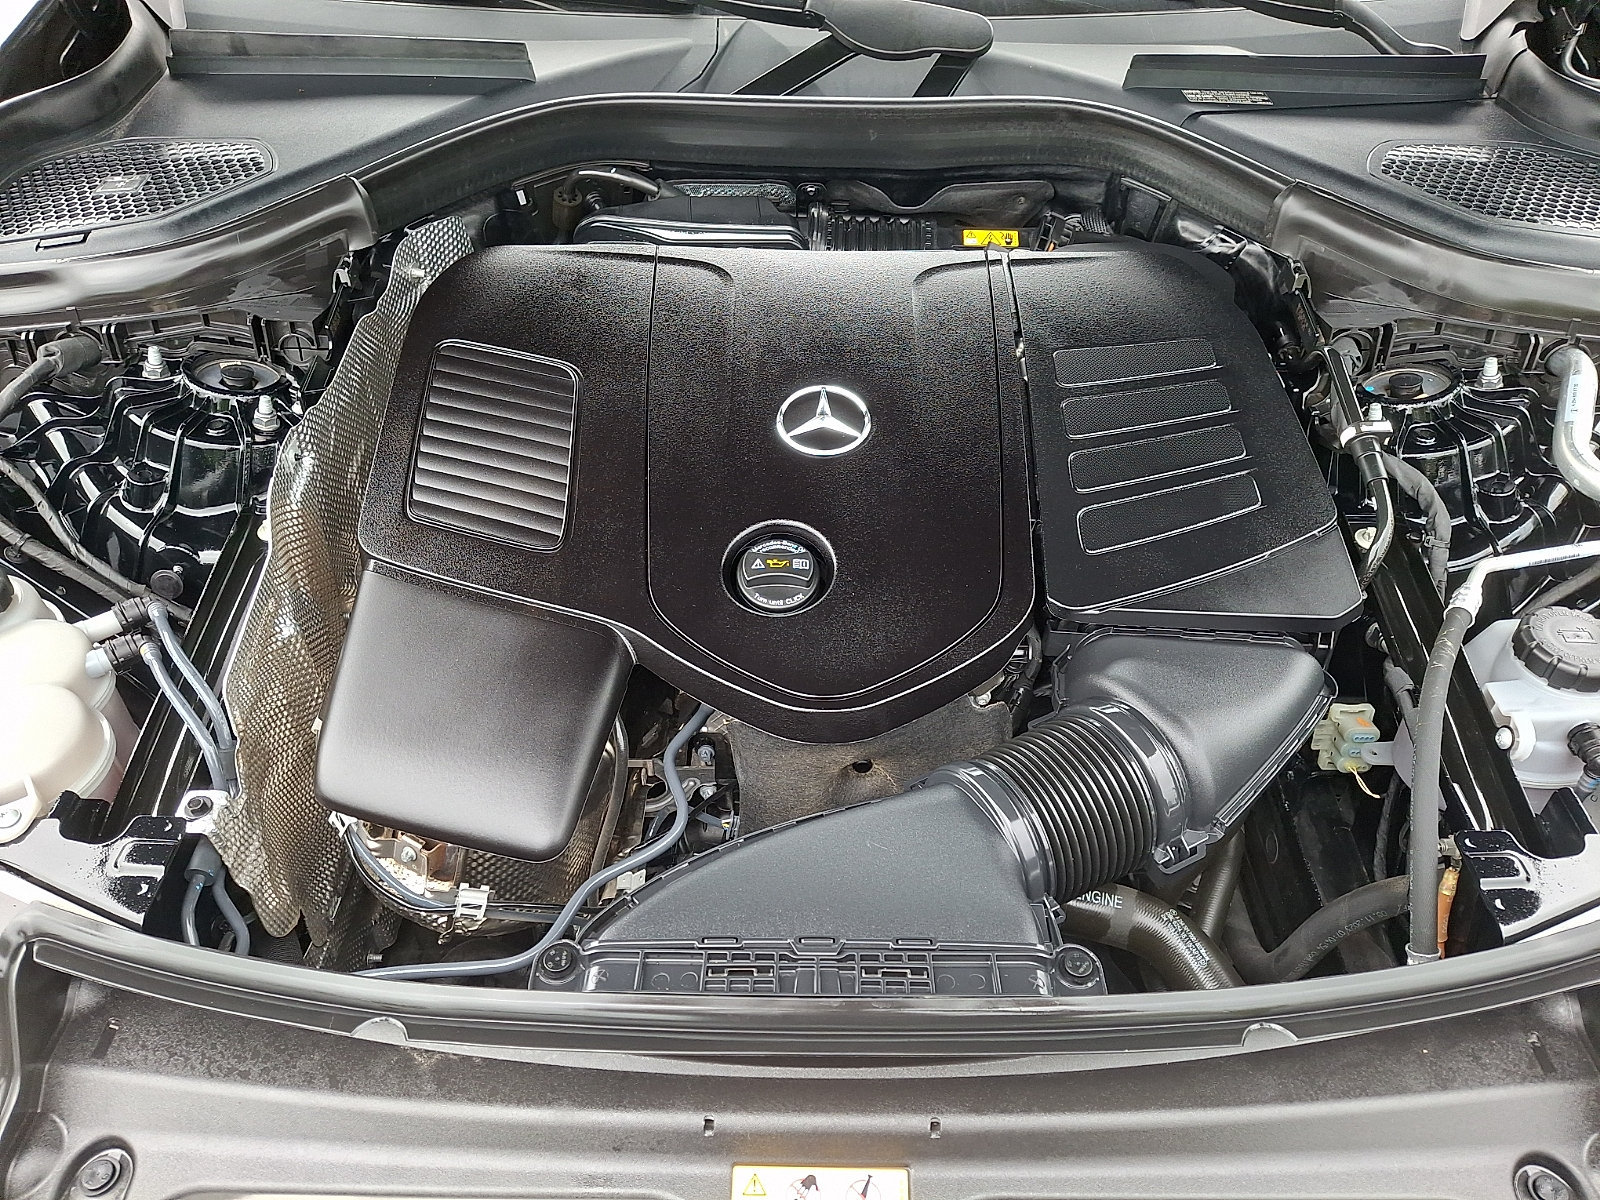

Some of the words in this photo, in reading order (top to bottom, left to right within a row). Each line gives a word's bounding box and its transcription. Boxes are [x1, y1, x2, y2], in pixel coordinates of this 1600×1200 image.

[754, 592, 768, 604] Turn
[786, 592, 805, 605] CLICK
[1076, 890, 1123, 909] NGINE
